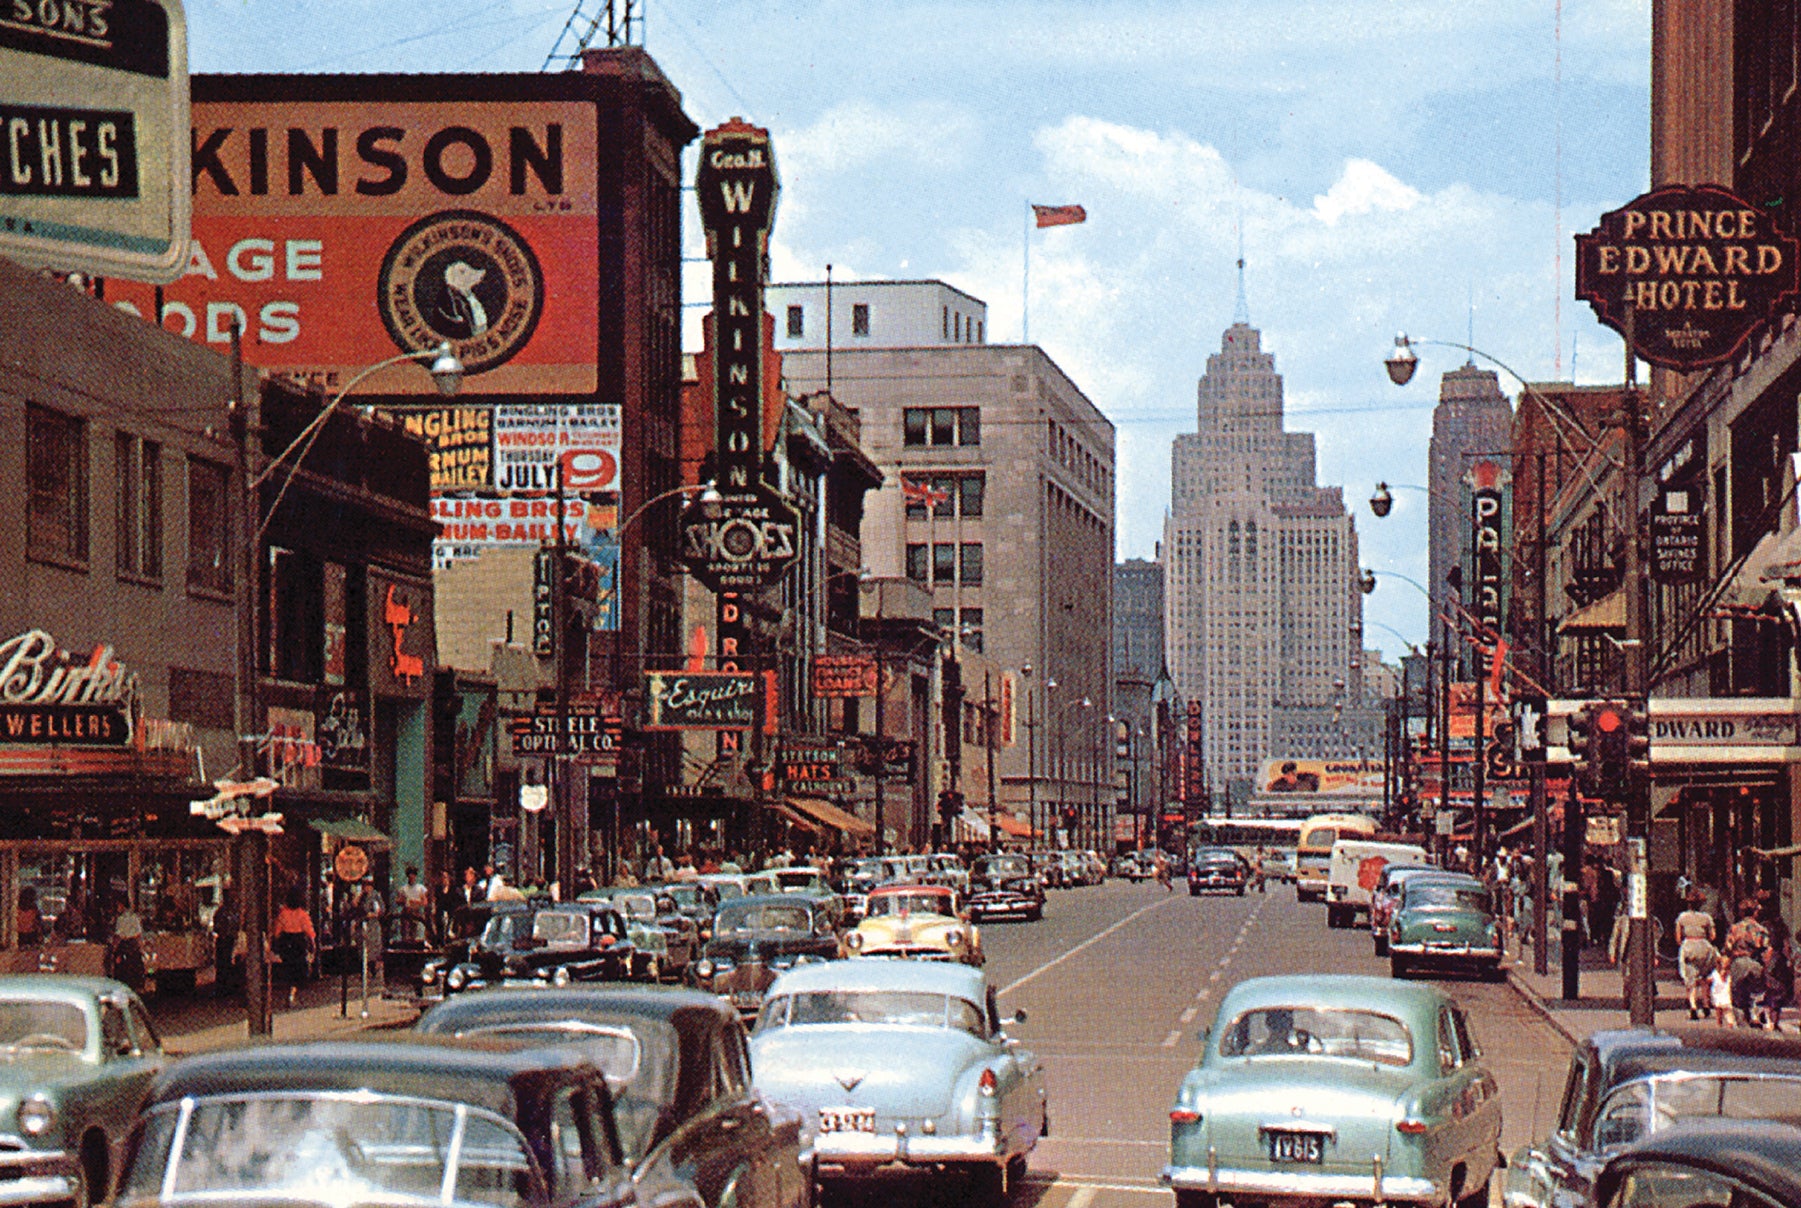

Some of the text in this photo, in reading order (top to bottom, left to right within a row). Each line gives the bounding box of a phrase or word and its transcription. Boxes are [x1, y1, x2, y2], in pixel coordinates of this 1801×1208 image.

[0, 117, 120, 187] CHES
[191, 123, 565, 197] KINSON
[1623, 210, 1758, 240] PRINCE
[185, 238, 324, 282] AGE
[1598, 245, 1783, 275] EDWARD
[1634, 280, 1748, 311] HOTEL
[113, 301, 301, 343] ODS
[720, 180, 755, 487] WILKINSON
[399, 409, 490, 438] NGLING
[497, 432, 570, 447] WINDSOR
[499, 448, 618, 489] JULY 9
[684, 519, 795, 561] SHOES
[0, 628, 138, 703] Birks
[6, 713, 112, 738] WELLERS
[534, 716, 599, 733] STELE
[522, 734, 590, 751] OPTIAL
[786, 764, 832, 780] HATS
